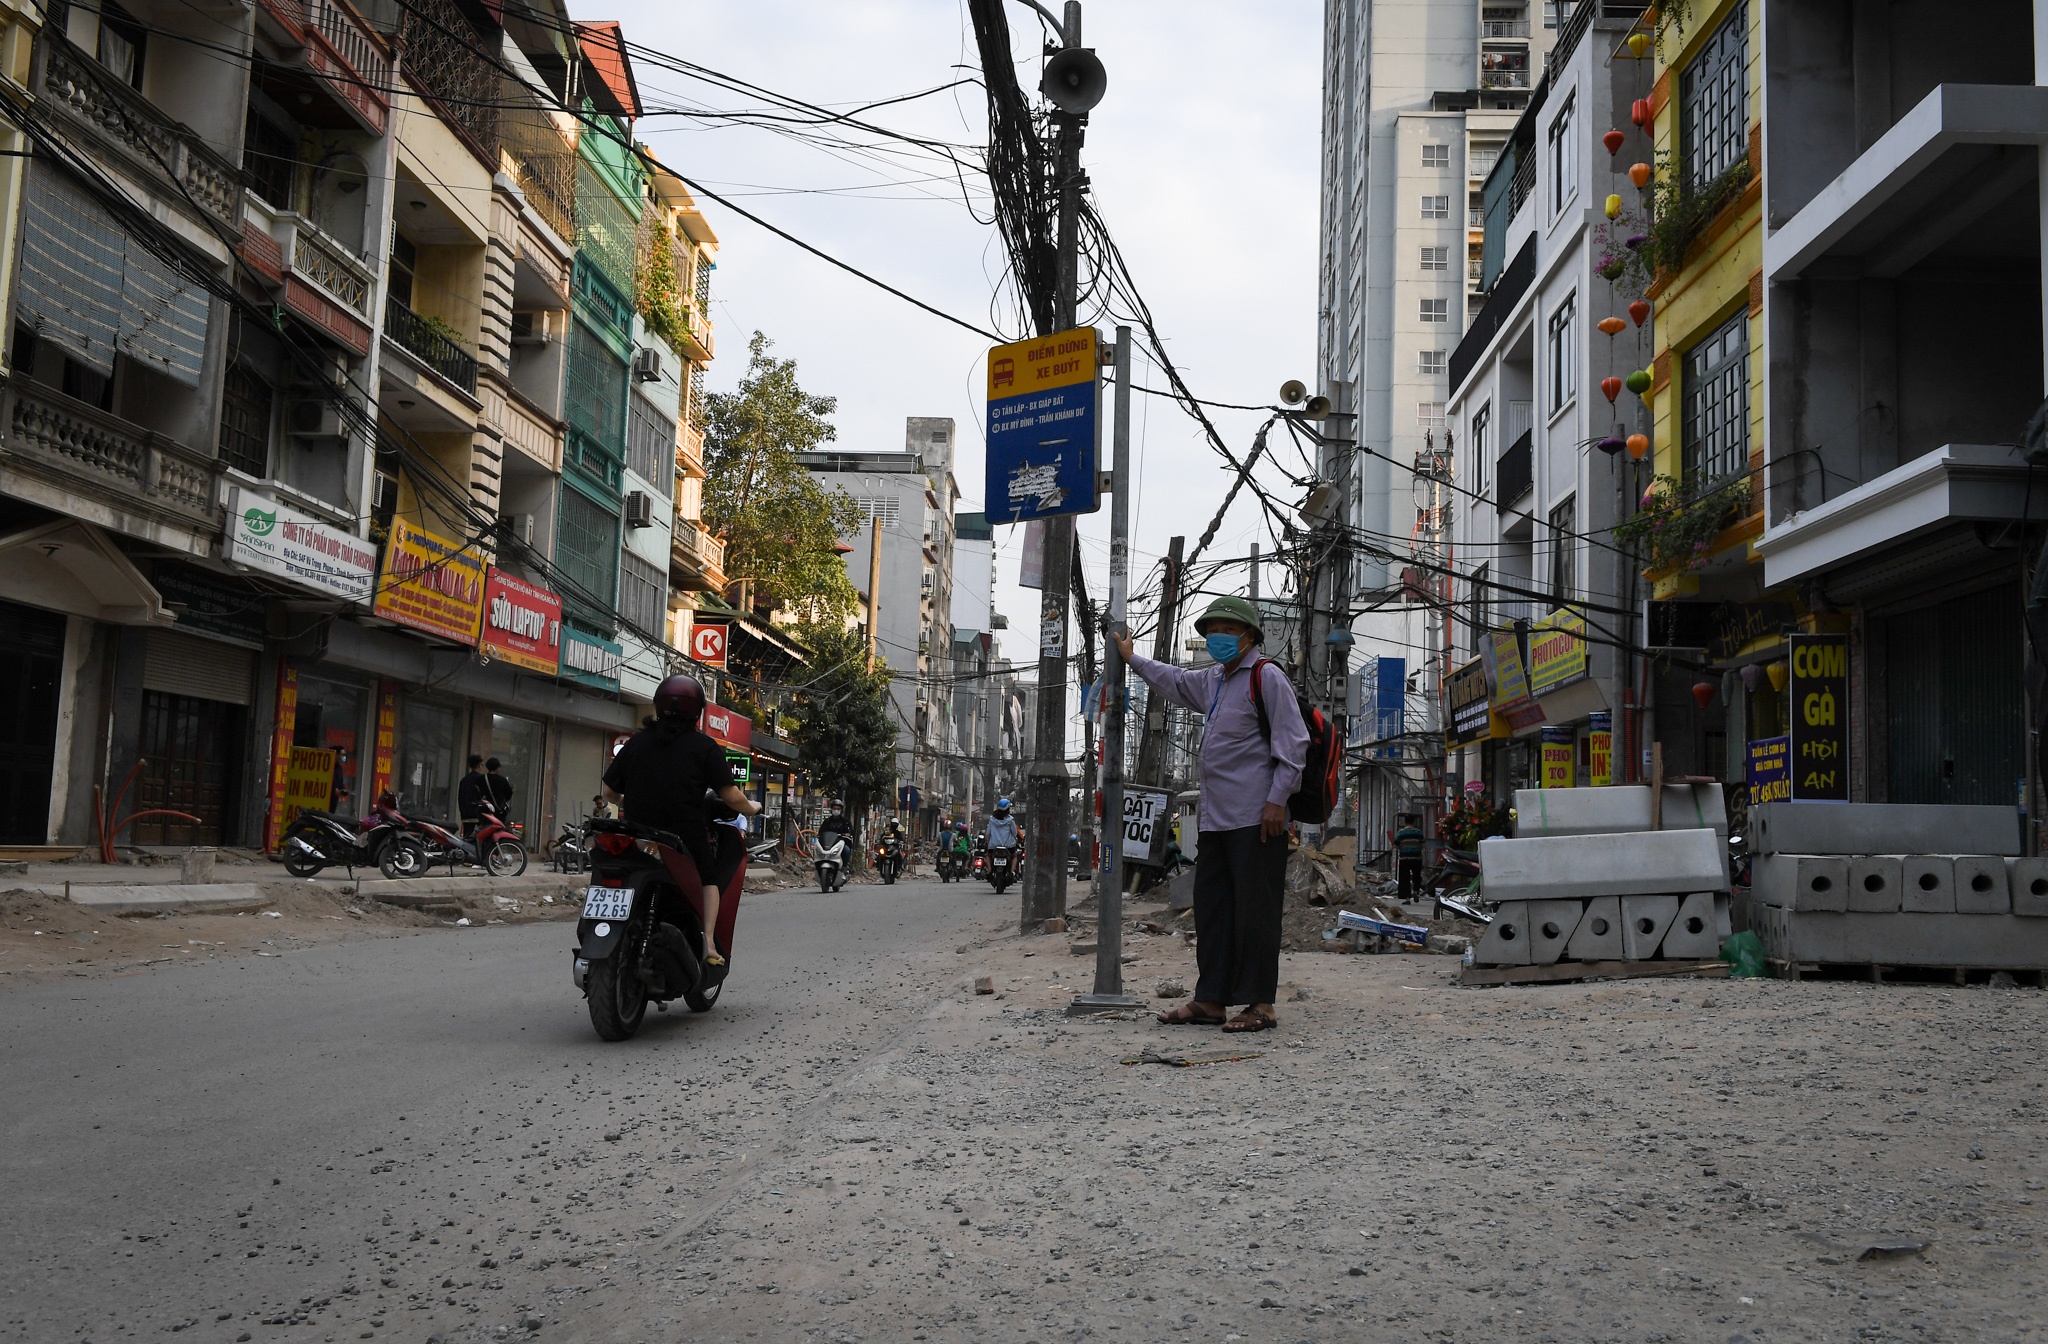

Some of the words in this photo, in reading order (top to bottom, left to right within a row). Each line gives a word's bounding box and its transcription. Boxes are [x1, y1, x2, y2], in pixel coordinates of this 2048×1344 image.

[1028, 343, 1055, 361] ĐIỂM
[1058, 339, 1088, 355] DỪNG
[1036, 366, 1050, 380] XE
[1053, 357, 1080, 376] BUÝT
[1001, 405, 1013, 416] TÂN
[1014, 404, 1025, 416] LẬP
[1030, 400, 1038, 411] BX
[1038, 396, 1052, 408] GIÁP
[1001, 423, 1010, 432] BX
[1010, 419, 1020, 430] MỸ
[1054, 408, 1074, 421] KHÁNH
[1075, 406, 1086, 417] DƯ
[298, 524, 305, 545] TY
[491, 592, 511, 631] SỬA
[511, 603, 546, 641] LAPTOP
[703, 635, 718, 650] K
[1532, 625, 1583, 668] PHOTOCOPY
[565, 639, 587, 670] ANH
[1793, 644, 1846, 679] CƠM
[1803, 686, 1836, 727] GÀ
[292, 752, 331, 773] PHOTO
[1544, 750, 1571, 762] PHO
[1592, 753, 1606, 777] IN
[1549, 767, 1566, 780] TO
[1803, 770, 1836, 790] AN
[289, 779, 300, 796] IN
[303, 776, 327, 799] MÀU
[592, 889, 627, 903] 29-G1
[585, 903, 628, 918] 212.65
